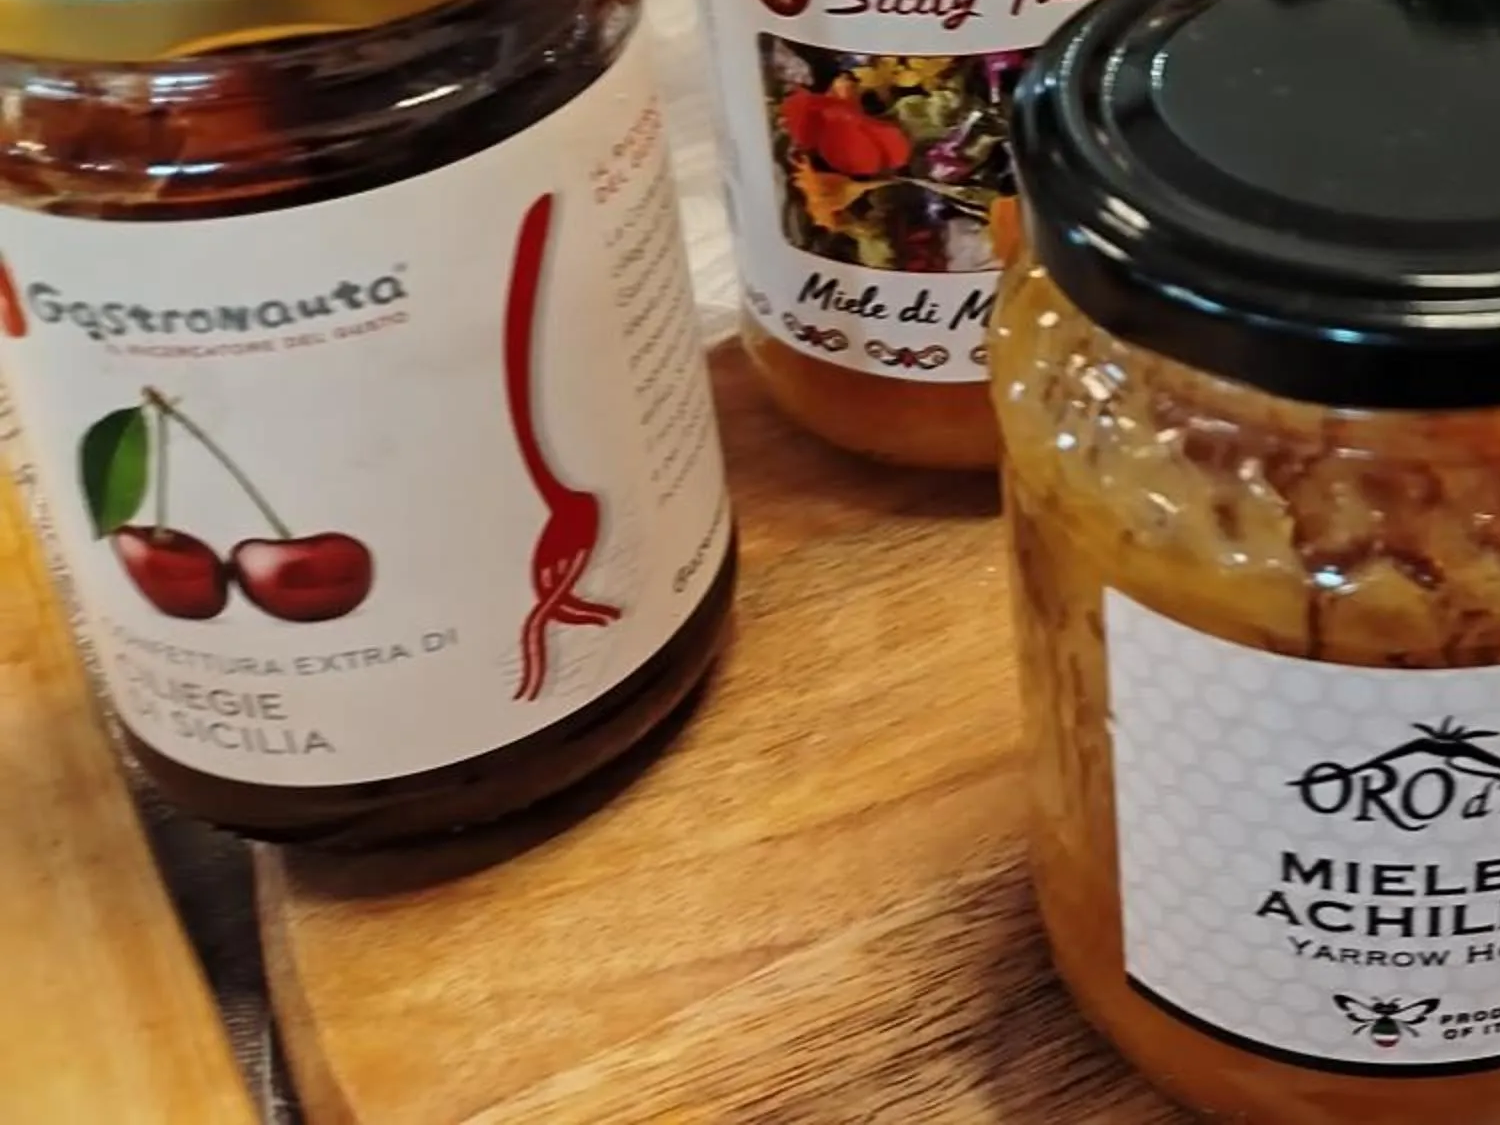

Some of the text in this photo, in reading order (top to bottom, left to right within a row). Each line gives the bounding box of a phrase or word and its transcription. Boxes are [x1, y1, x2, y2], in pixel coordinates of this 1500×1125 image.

[797, 272, 889, 319] Miele
[898, 289, 942, 324] di
[294, 644, 412, 676] EXTRA
[420, 627, 459, 654] DI
[1299, 761, 1457, 832] ORO
[1288, 935, 1450, 968] YARROW
[1443, 1026, 1474, 1040] OF
